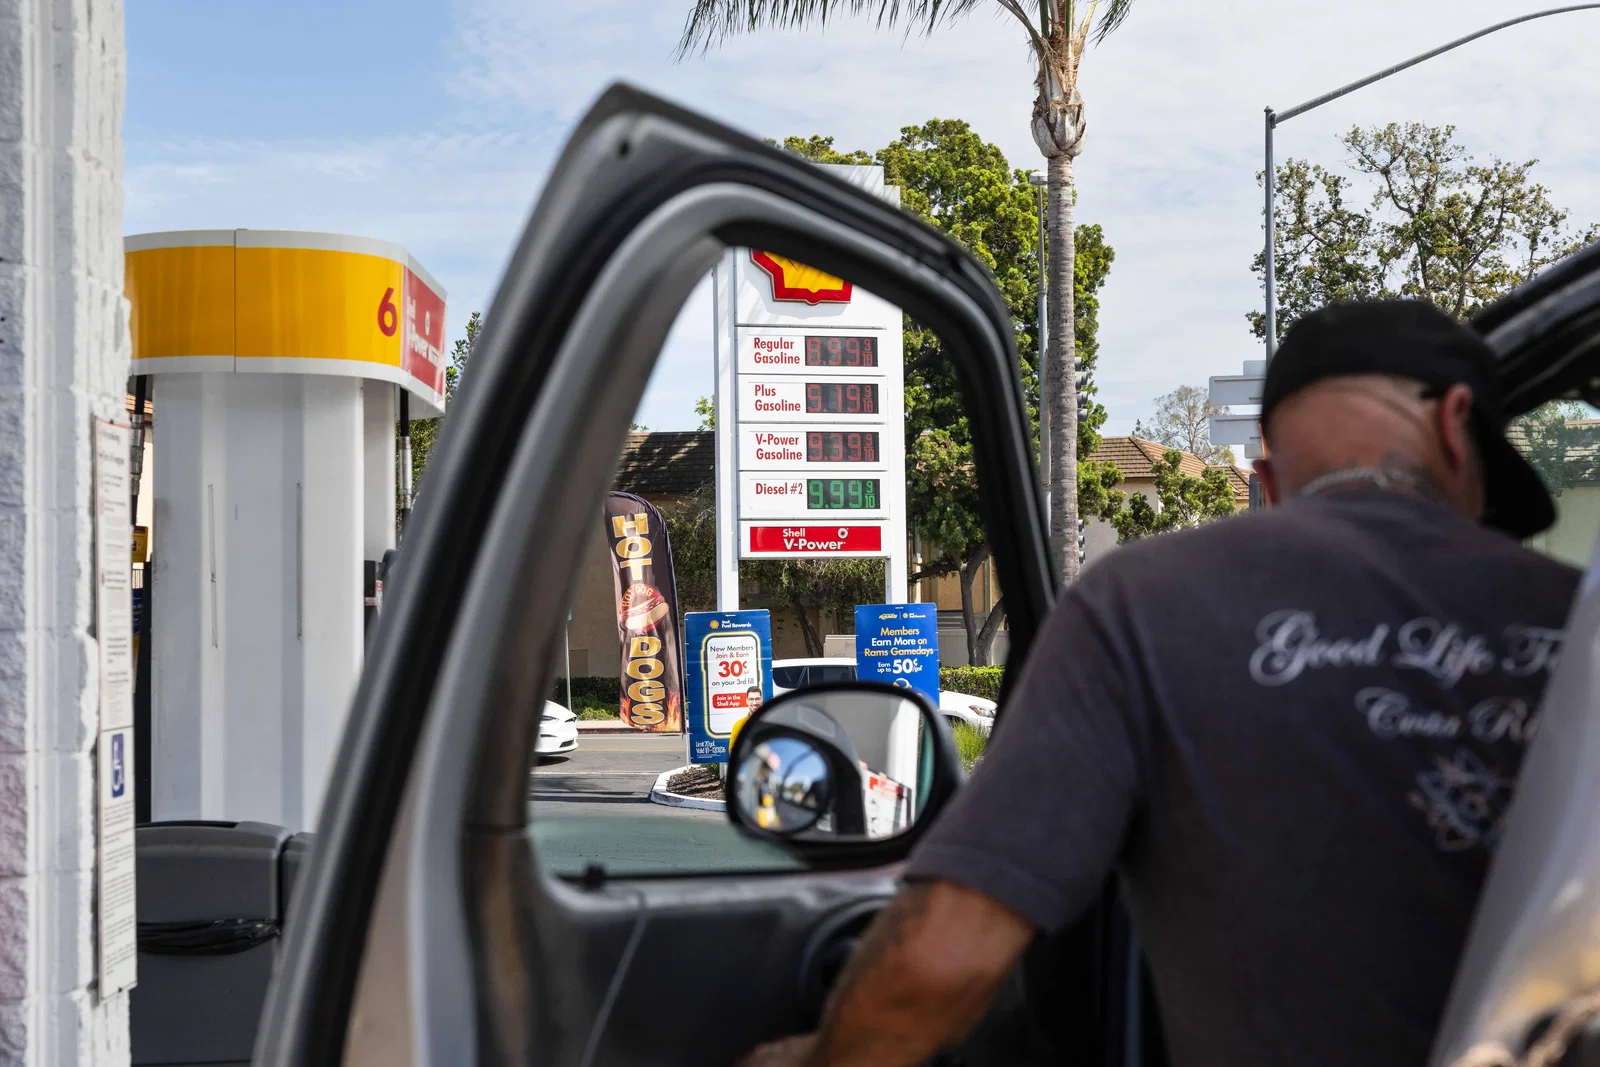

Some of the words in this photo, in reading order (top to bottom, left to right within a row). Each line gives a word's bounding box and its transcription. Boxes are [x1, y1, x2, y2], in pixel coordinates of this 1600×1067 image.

[377, 287, 397, 336] 6
[753, 337, 794, 352] Regular
[753, 352, 801, 365] Gasoline
[807, 337, 860, 366] 8.99
[754, 384, 776, 397] Plus
[754, 399, 801, 412] Gasoline
[807, 384, 860, 413] 9.19
[755, 433, 799, 445] V-Power
[756, 448, 802, 461] Gasoline
[808, 433, 861, 462] 9.39
[755, 483, 788, 495] Diesel
[790, 483, 803, 495] #2
[809, 480, 862, 509] 9.99
[782, 528, 806, 537] Shell
[612, 513, 652, 581] HOT
[783, 538, 843, 550] V-Power
[621, 588, 635, 607] HOT
[635, 585, 653, 597] DOG
[880, 626, 920, 636] Members
[871, 637, 892, 647] Earn
[893, 636, 916, 646] More
[1249, 608, 1390, 687] Good
[1392, 615, 1496, 690] Life
[864, 647, 889, 657] Rams
[890, 646, 934, 657] Gamedays
[626, 636, 666, 725] DOGS
[721, 680, 735, 688] your
